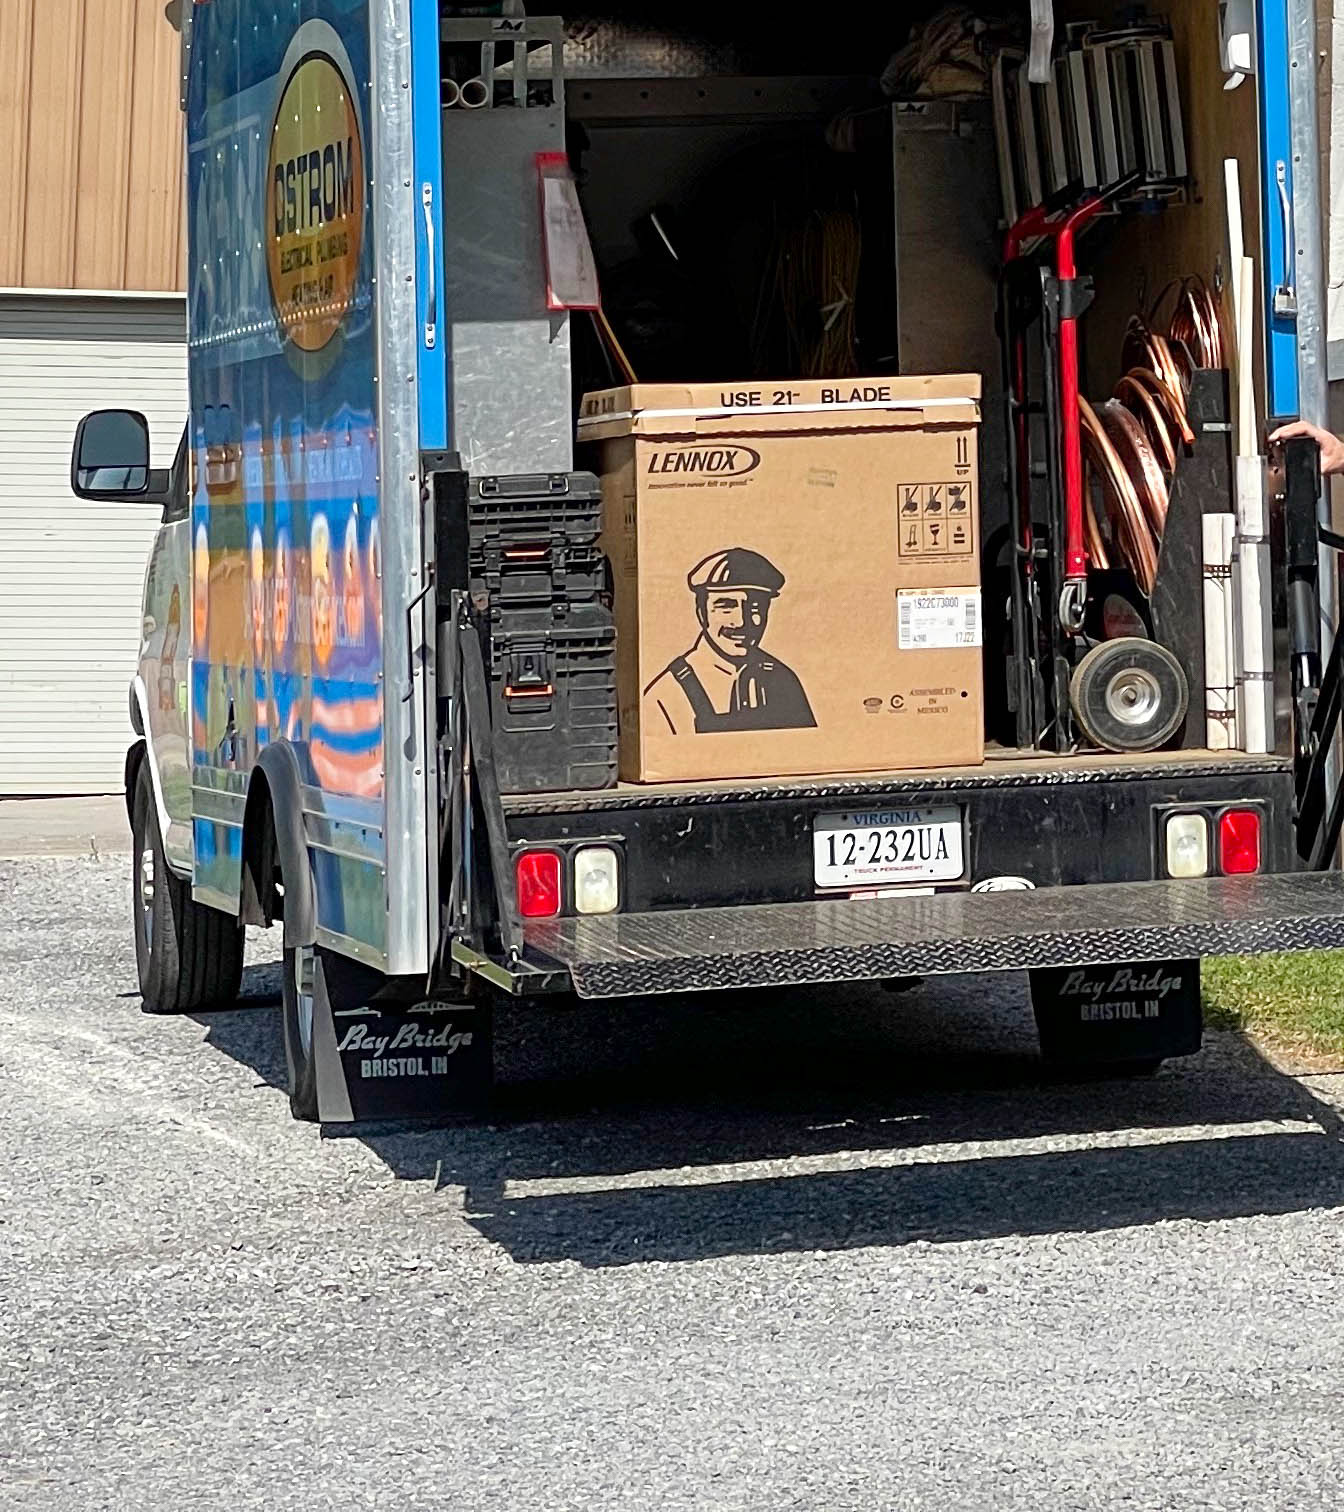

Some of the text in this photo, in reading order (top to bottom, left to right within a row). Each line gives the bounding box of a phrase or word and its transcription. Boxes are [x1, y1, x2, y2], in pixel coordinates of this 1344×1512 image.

[274, 136, 353, 238] OSTROM
[720, 391, 762, 408] USE
[820, 386, 891, 404] BLADE
[647, 450, 738, 474] LENNOX
[853, 811, 922, 826] VIRGINIA
[826, 827, 950, 867] 12-232UA
[1059, 968, 1182, 1001] Bay Bridge
[1145, 999, 1160, 1018] IN
[337, 1023, 473, 1058] Bay Bridge
[361, 1056, 448, 1078] BRISTOL, IN
